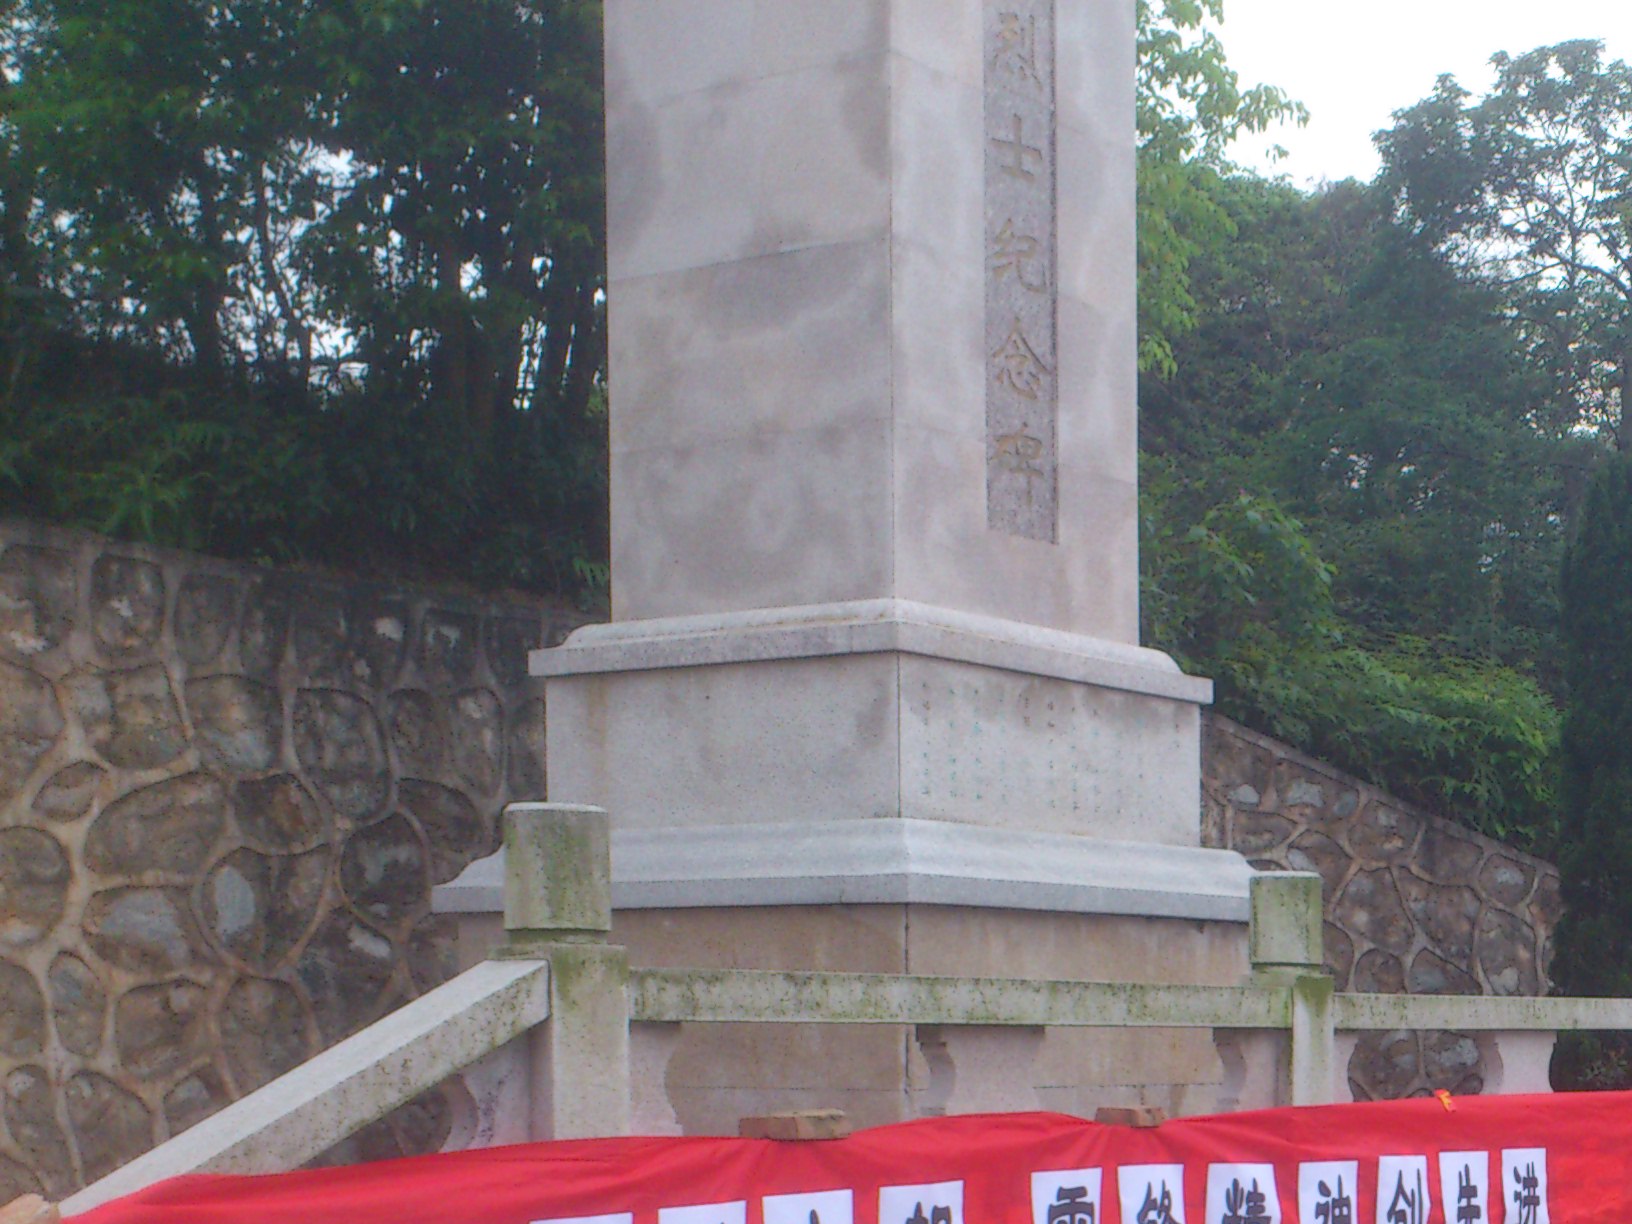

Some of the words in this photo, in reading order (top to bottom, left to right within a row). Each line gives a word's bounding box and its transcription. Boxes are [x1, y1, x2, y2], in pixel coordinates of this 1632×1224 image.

[991, 12, 1047, 505] 烈士纪念碑
